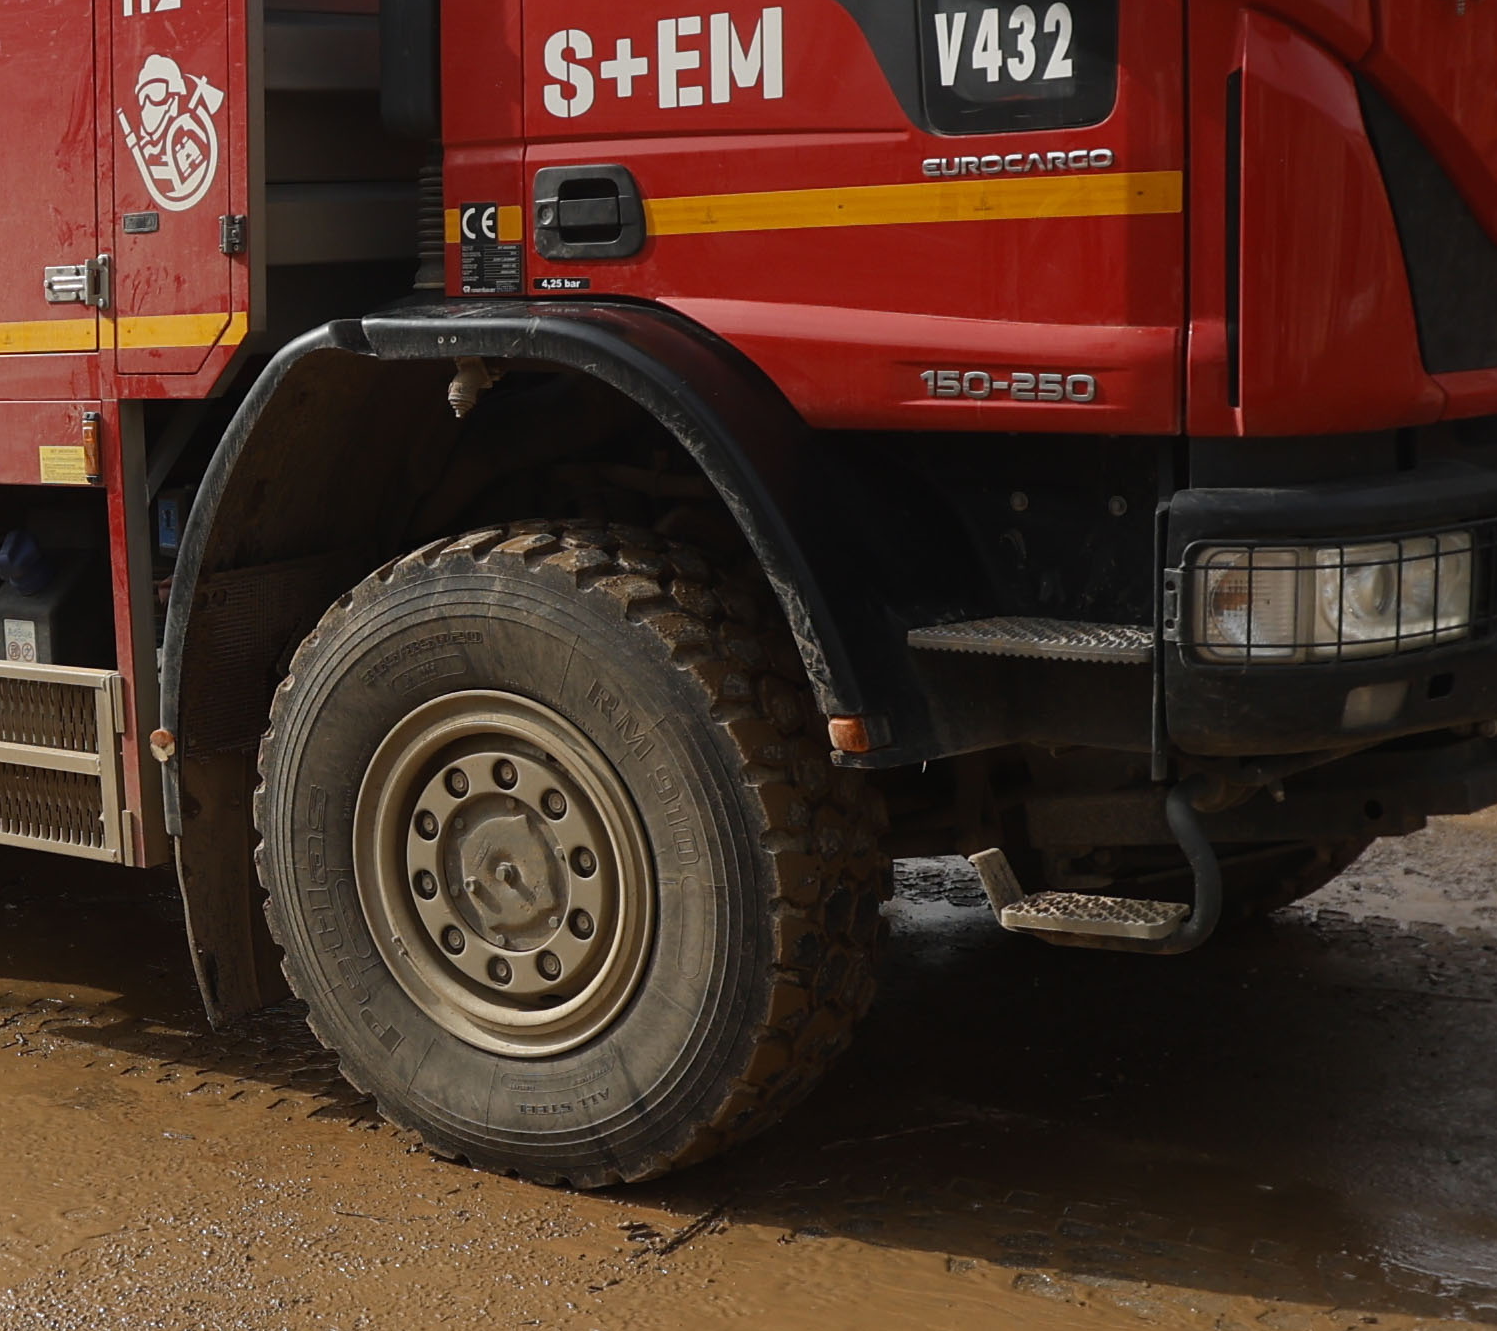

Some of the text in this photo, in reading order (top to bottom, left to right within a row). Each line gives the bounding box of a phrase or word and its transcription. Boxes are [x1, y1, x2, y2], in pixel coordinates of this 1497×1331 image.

[934, 2, 1074, 87] V432
[544, 7, 784, 118] S+EM
[922, 148, 1115, 178] EUROCARGO
[541, 278, 581, 289] 4,25 bar
[919, 370, 1097, 403] 150-250
[586, 678, 656, 762] RM
[520, 1101, 573, 1116] STEEL
